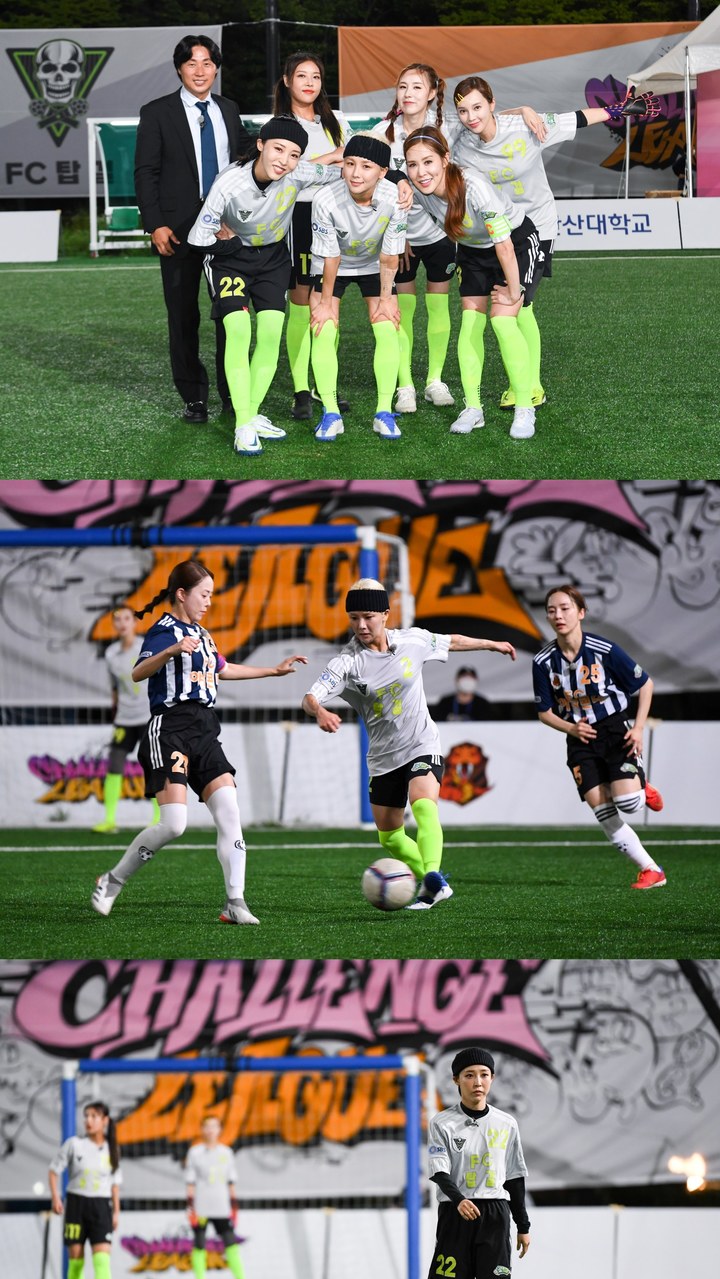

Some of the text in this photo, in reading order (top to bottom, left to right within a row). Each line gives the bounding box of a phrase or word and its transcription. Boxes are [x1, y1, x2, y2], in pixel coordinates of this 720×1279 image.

[501, 138, 527, 161] 99
[5, 161, 47, 185] FC
[219, 276, 246, 299] 22
[401, 657, 413, 679] 2
[580, 664, 600, 685] 25
[14, 959, 552, 1058] CHALLENGE
[487, 1127, 509, 1149] 22
[469, 1153, 492, 1169] FC
[435, 1253, 457, 1278] 22
